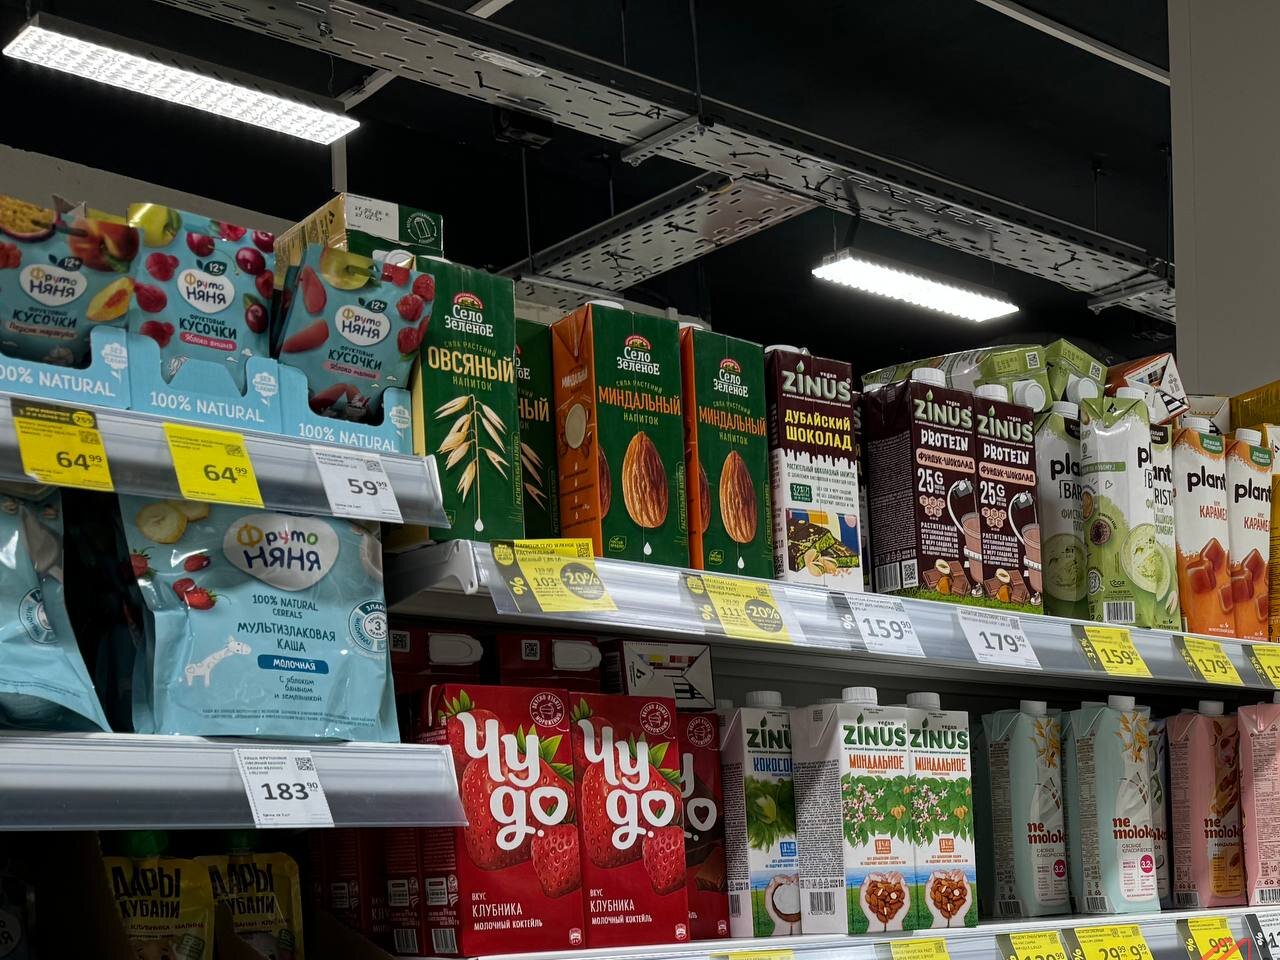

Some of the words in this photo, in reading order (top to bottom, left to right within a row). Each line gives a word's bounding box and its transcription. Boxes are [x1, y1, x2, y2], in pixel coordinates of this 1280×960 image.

[13, 309, 77, 328] КУСОЧКИ
[452, 304, 483, 324] Село
[179, 318, 237, 340] КУСОЧКИ
[328, 349, 382, 370] КУСОЧКИ
[427, 346, 516, 384] ОВСЯНЫЙ
[623, 346, 651, 363] Село
[39, 371, 115, 397] NATURAL
[452, 375, 493, 392] НАПИТОК
[781, 361, 851, 401] ZINUS
[151, 391, 192, 412] 100%
[197, 399, 264, 423] NATURAL
[598, 386, 681, 416] МИНДАЛЬНЫЙ
[913, 390, 973, 429] ZINUS
[623, 411, 659, 426] НАПИТОК
[699, 406, 767, 437] МИНДАЛЬНЫЙ
[785, 409, 851, 431] ДУБАЙСКИЙ
[976, 407, 1034, 443] ZINUS
[340, 430, 399, 453] NATURAL
[786, 425, 852, 451] ШОКОЛАД
[920, 428, 969, 451] PROTEIN
[57, 451, 90, 471] 64
[983, 443, 1030, 465] PROTEIN
[204, 464, 238, 484] 64
[917, 467, 935, 493] 25
[348, 478, 378, 496] 59
[236, 523, 319, 549] Фруто
[243, 547, 322, 573] НЯНЯ
[272, 608, 303, 619] CEREALS
[280, 597, 318, 612] NATURAL
[747, 607, 780, 621] -20%
[237, 621, 336, 642] МУЛЬТИЗЛАКОВАЯ
[862, 617, 904, 640] 159
[276, 638, 307, 652] КАША
[978, 630, 1019, 652] 179
[272, 658, 316, 671] МОЛОЧНАЯ
[1100, 648, 1133, 666] 159
[1198, 658, 1228, 674] 179
[849, 754, 905, 770] МИНДАЛЬНОЕ
[914, 756, 967, 772] МИНДАЛЬНОЕ
[261, 782, 309, 801] 183
[110, 865, 181, 898] ДАРЫ
[207, 862, 275, 895] ДАРЫ
[119, 900, 181, 921] КУБАНИ
[471, 902, 523, 918] КЛУБНИКА
[589, 898, 635, 913] КЛУБНИКА
[473, 919, 510, 931] МОЛОЧНЫЙ
[511, 918, 543, 930] КОКТЕЙЛЬ
[591, 914, 624, 926] МОЛОЧНЫЙ
[625, 913, 653, 924] КОКТЕЙЛЬ
